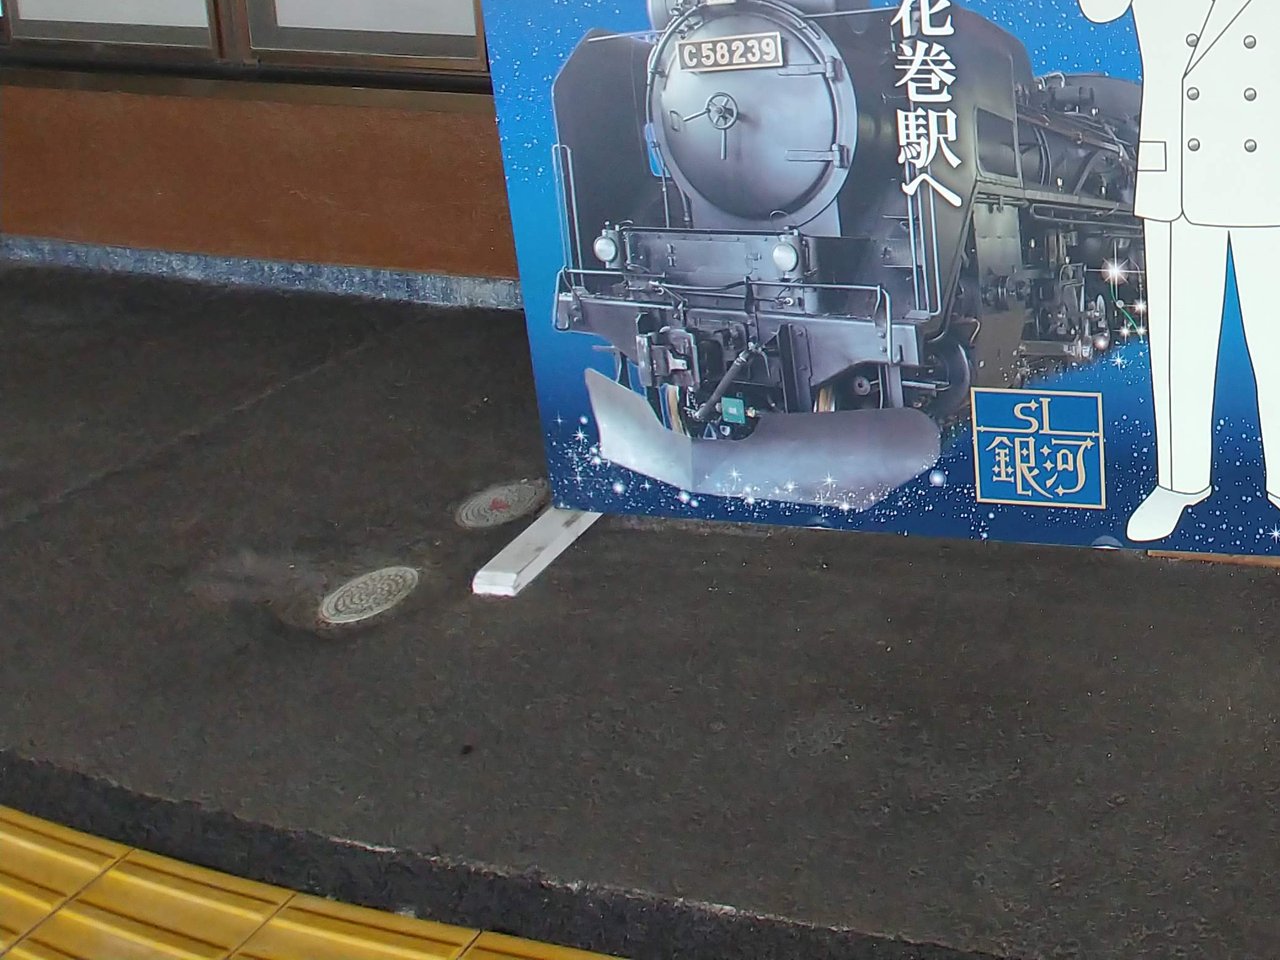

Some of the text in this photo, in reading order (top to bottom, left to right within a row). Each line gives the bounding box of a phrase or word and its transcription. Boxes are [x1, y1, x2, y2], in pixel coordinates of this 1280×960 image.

[683, 38, 776, 67] C58239
[1013, 397, 1052, 434] SL
[985, 436, 1096, 499] 銀河
